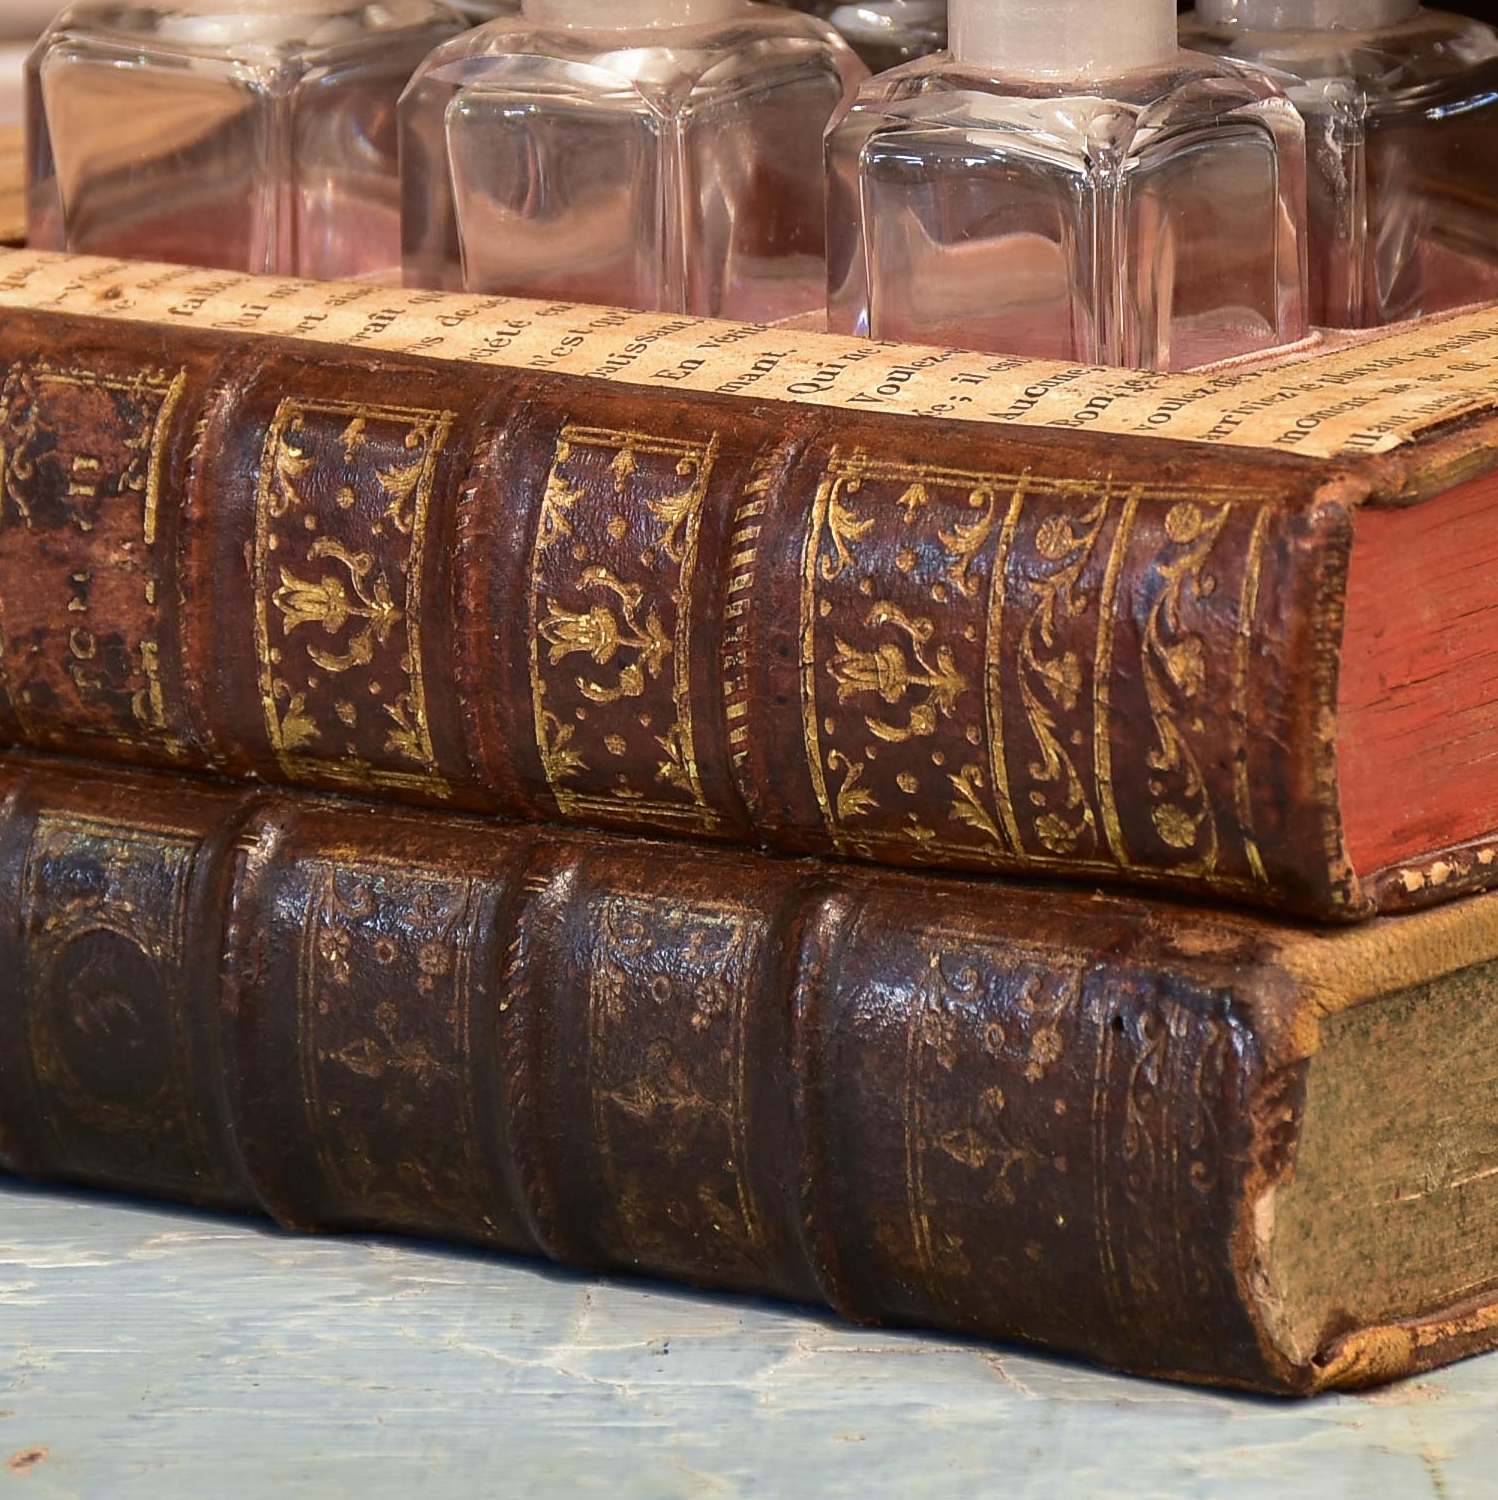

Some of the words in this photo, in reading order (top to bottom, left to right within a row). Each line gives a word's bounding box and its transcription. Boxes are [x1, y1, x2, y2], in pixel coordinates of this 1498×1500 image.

[435, 308, 479, 328] de
[526, 328, 595, 368] n'est
[648, 359, 707, 382] En
[786, 361, 848, 395] Qui
[838, 347, 883, 363] ne
[949, 372, 991, 387] il
[1287, 381, 1324, 396] le
[987, 366, 1108, 422] Aucune,
[1133, 385, 1219, 431] voulez
[1272, 395, 1381, 445] moment
[1378, 382, 1421, 395] ne
[1416, 372, 1456, 384] se
